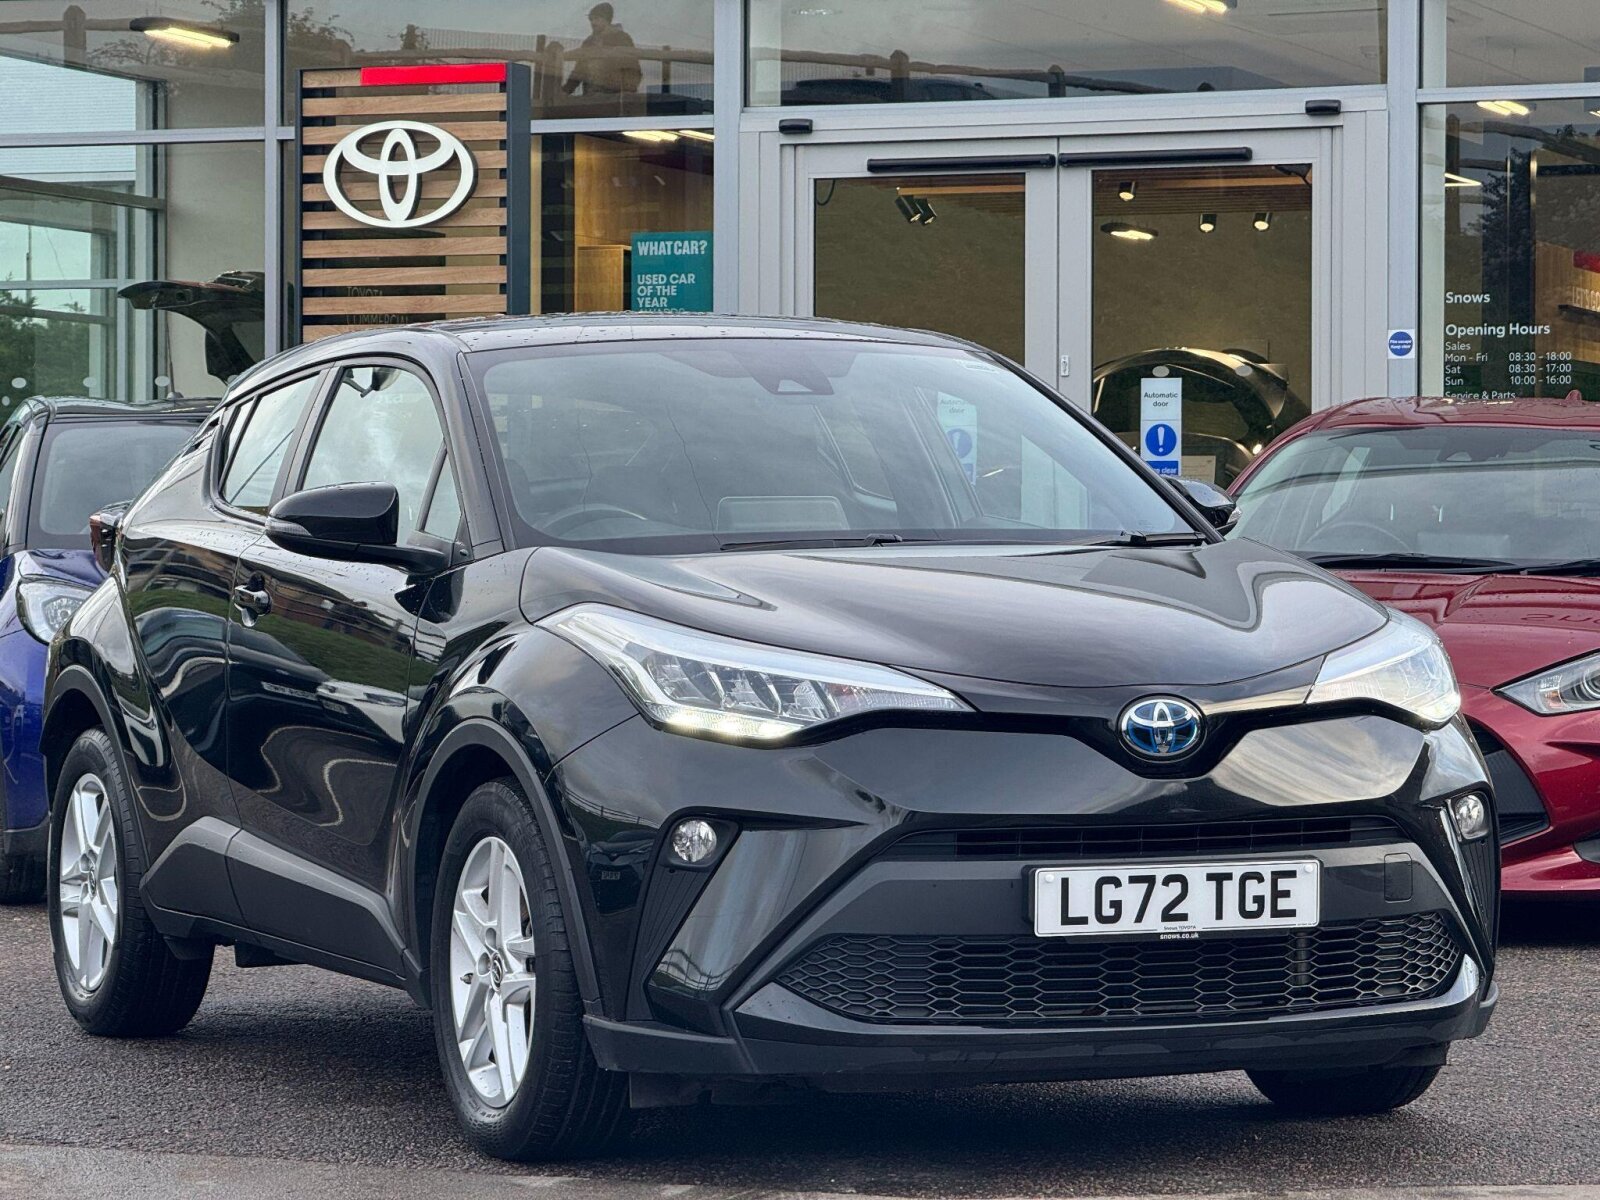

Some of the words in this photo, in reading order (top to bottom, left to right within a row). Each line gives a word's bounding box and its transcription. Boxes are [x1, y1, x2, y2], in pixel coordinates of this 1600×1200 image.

[637, 241, 673, 256] WHAT
[673, 239, 707, 255] CAR?
[637, 274, 667, 285] USED
[669, 273, 696, 284] CAR
[637, 285, 653, 296] OF
[656, 285, 677, 296] THE
[637, 296, 668, 308] YEAR
[1445, 291, 1491, 304] Snows
[1445, 323, 1506, 338] Opening
[1509, 323, 1551, 335] Hours
[1445, 341, 1471, 351] Sales
[1445, 353, 1467, 362] Mon
[1475, 353, 1488, 362] Fri
[1508, 352, 1536, 362] 08:30
[1546, 352, 1572, 361] 18:00
[1445, 365, 1461, 374] Sat
[1508, 364, 1536, 373] 08:30
[1546, 363, 1572, 373] 17:00
[1445, 376, 1464, 386] Sun
[1510, 375, 1536, 385] 10:00
[1546, 375, 1572, 385] 16:00
[1445, 391, 1480, 399] Service
[1482, 391, 1489, 399] &
[1491, 391, 1516, 399] Parts
[1060, 873, 1189, 926] LG72
[1206, 870, 1297, 921] TGE
[1160, 932, 1199, 940] snows.co.uk
